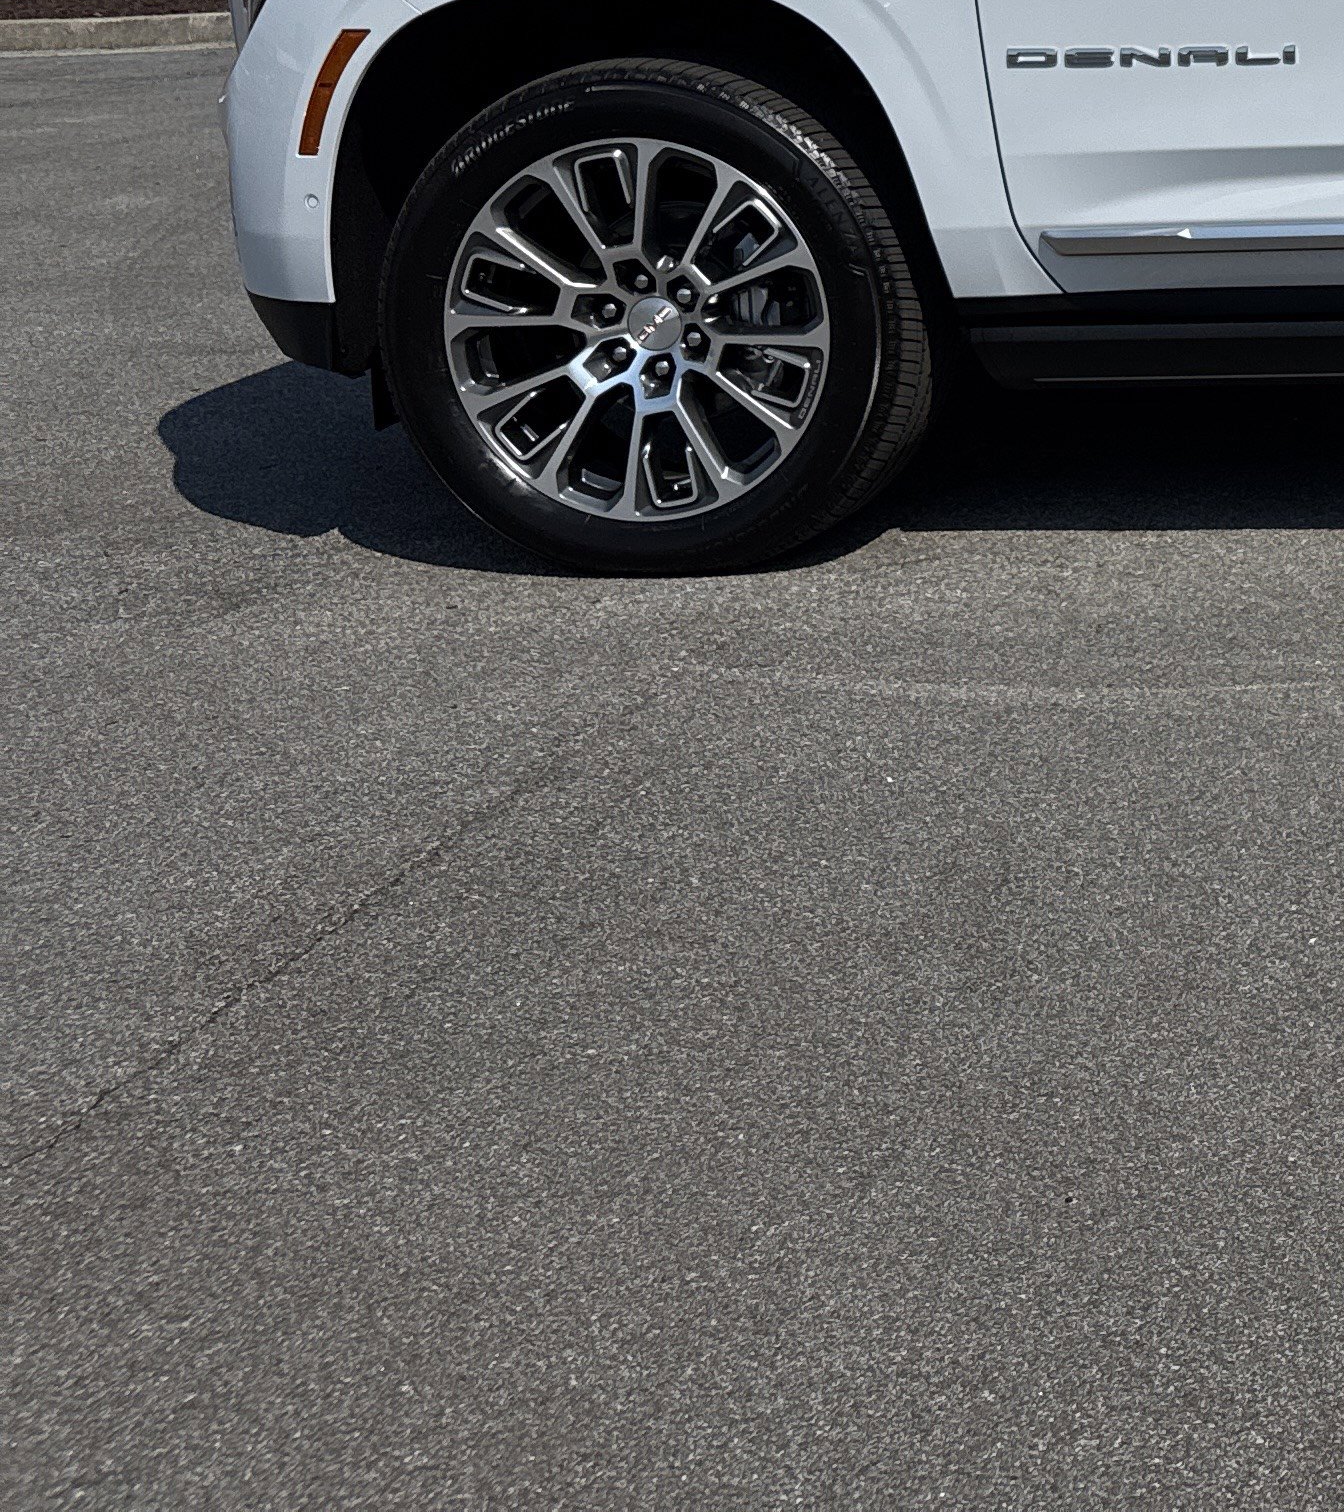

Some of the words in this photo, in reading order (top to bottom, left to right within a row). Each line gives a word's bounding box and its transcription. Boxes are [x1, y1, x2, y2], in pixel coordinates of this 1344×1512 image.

[1006, 44, 1296, 69] DENALI
[637, 306, 672, 342] GMC
[798, 360, 821, 419] DENALI
